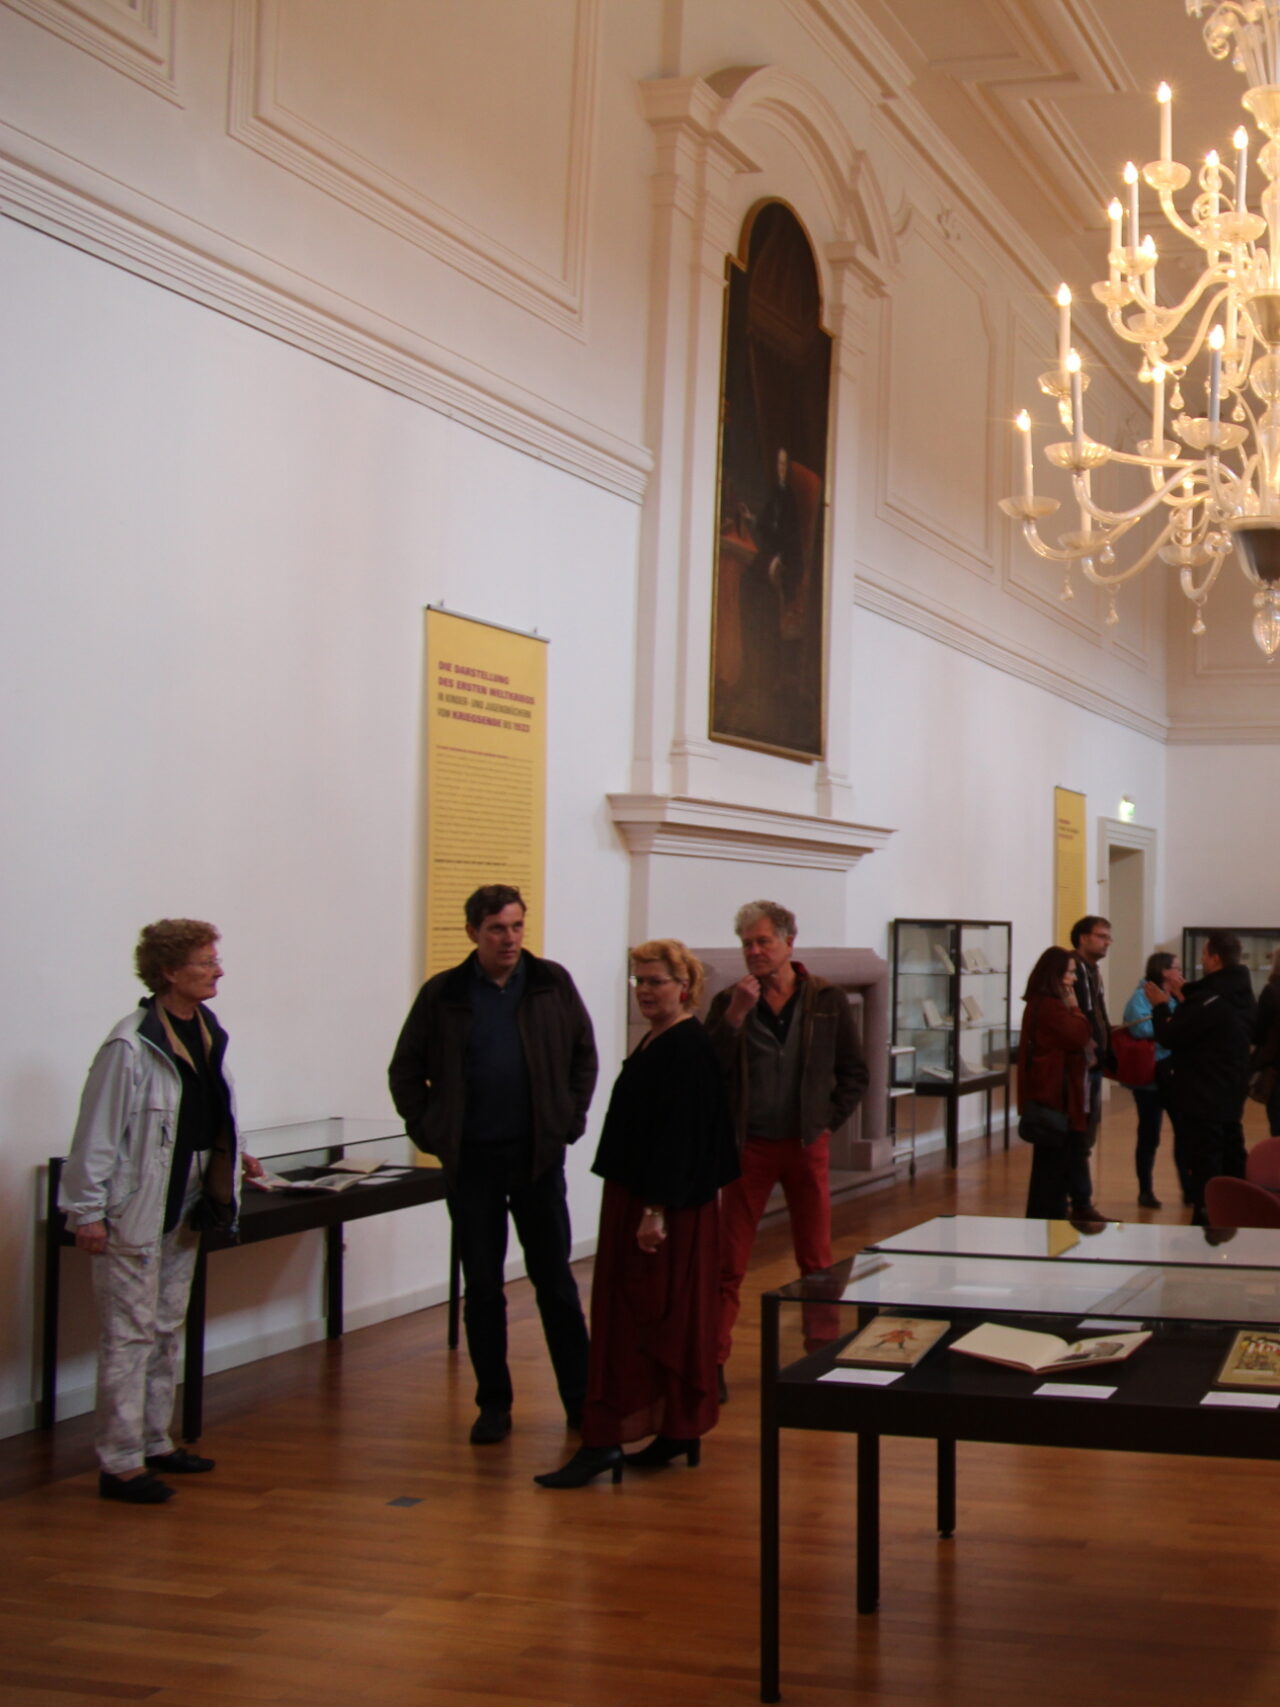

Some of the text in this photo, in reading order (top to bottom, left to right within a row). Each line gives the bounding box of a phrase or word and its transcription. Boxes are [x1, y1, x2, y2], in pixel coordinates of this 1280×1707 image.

[438, 660, 509, 685] DIE DARSTELLUNG
[438, 676, 454, 688] DES
[456, 680, 487, 695] ERSTEN
